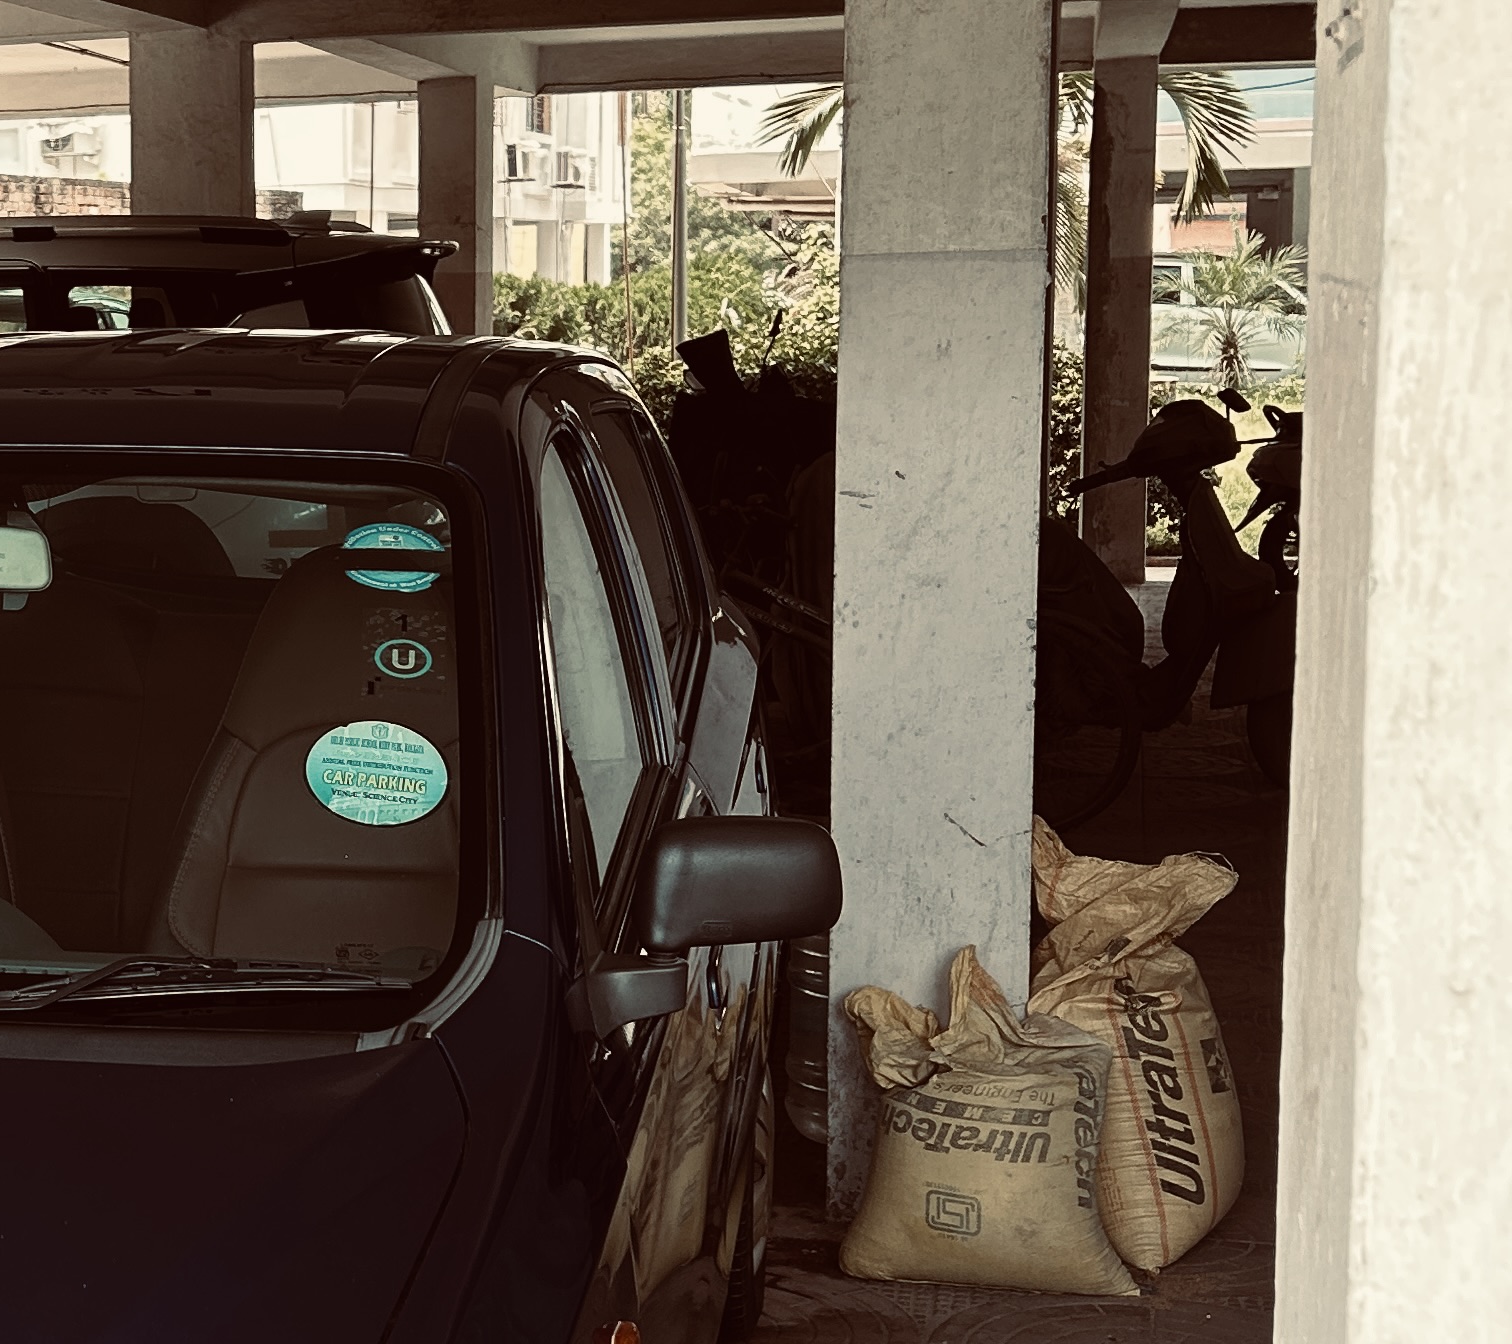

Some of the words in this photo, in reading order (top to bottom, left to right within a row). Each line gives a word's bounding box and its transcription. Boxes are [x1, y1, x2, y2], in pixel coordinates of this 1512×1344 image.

[391, 648, 416, 670] U
[322, 769, 354, 787] CAR
[356, 772, 428, 796] PARKING
[932, 1081, 1025, 1103] Engineer's
[1029, 1090, 1056, 1107] The
[1113, 976, 1206, 1206] UltraTe
[905, 1093, 1045, 1125] CEMEN
[882, 1103, 1052, 1164] UltraTech
